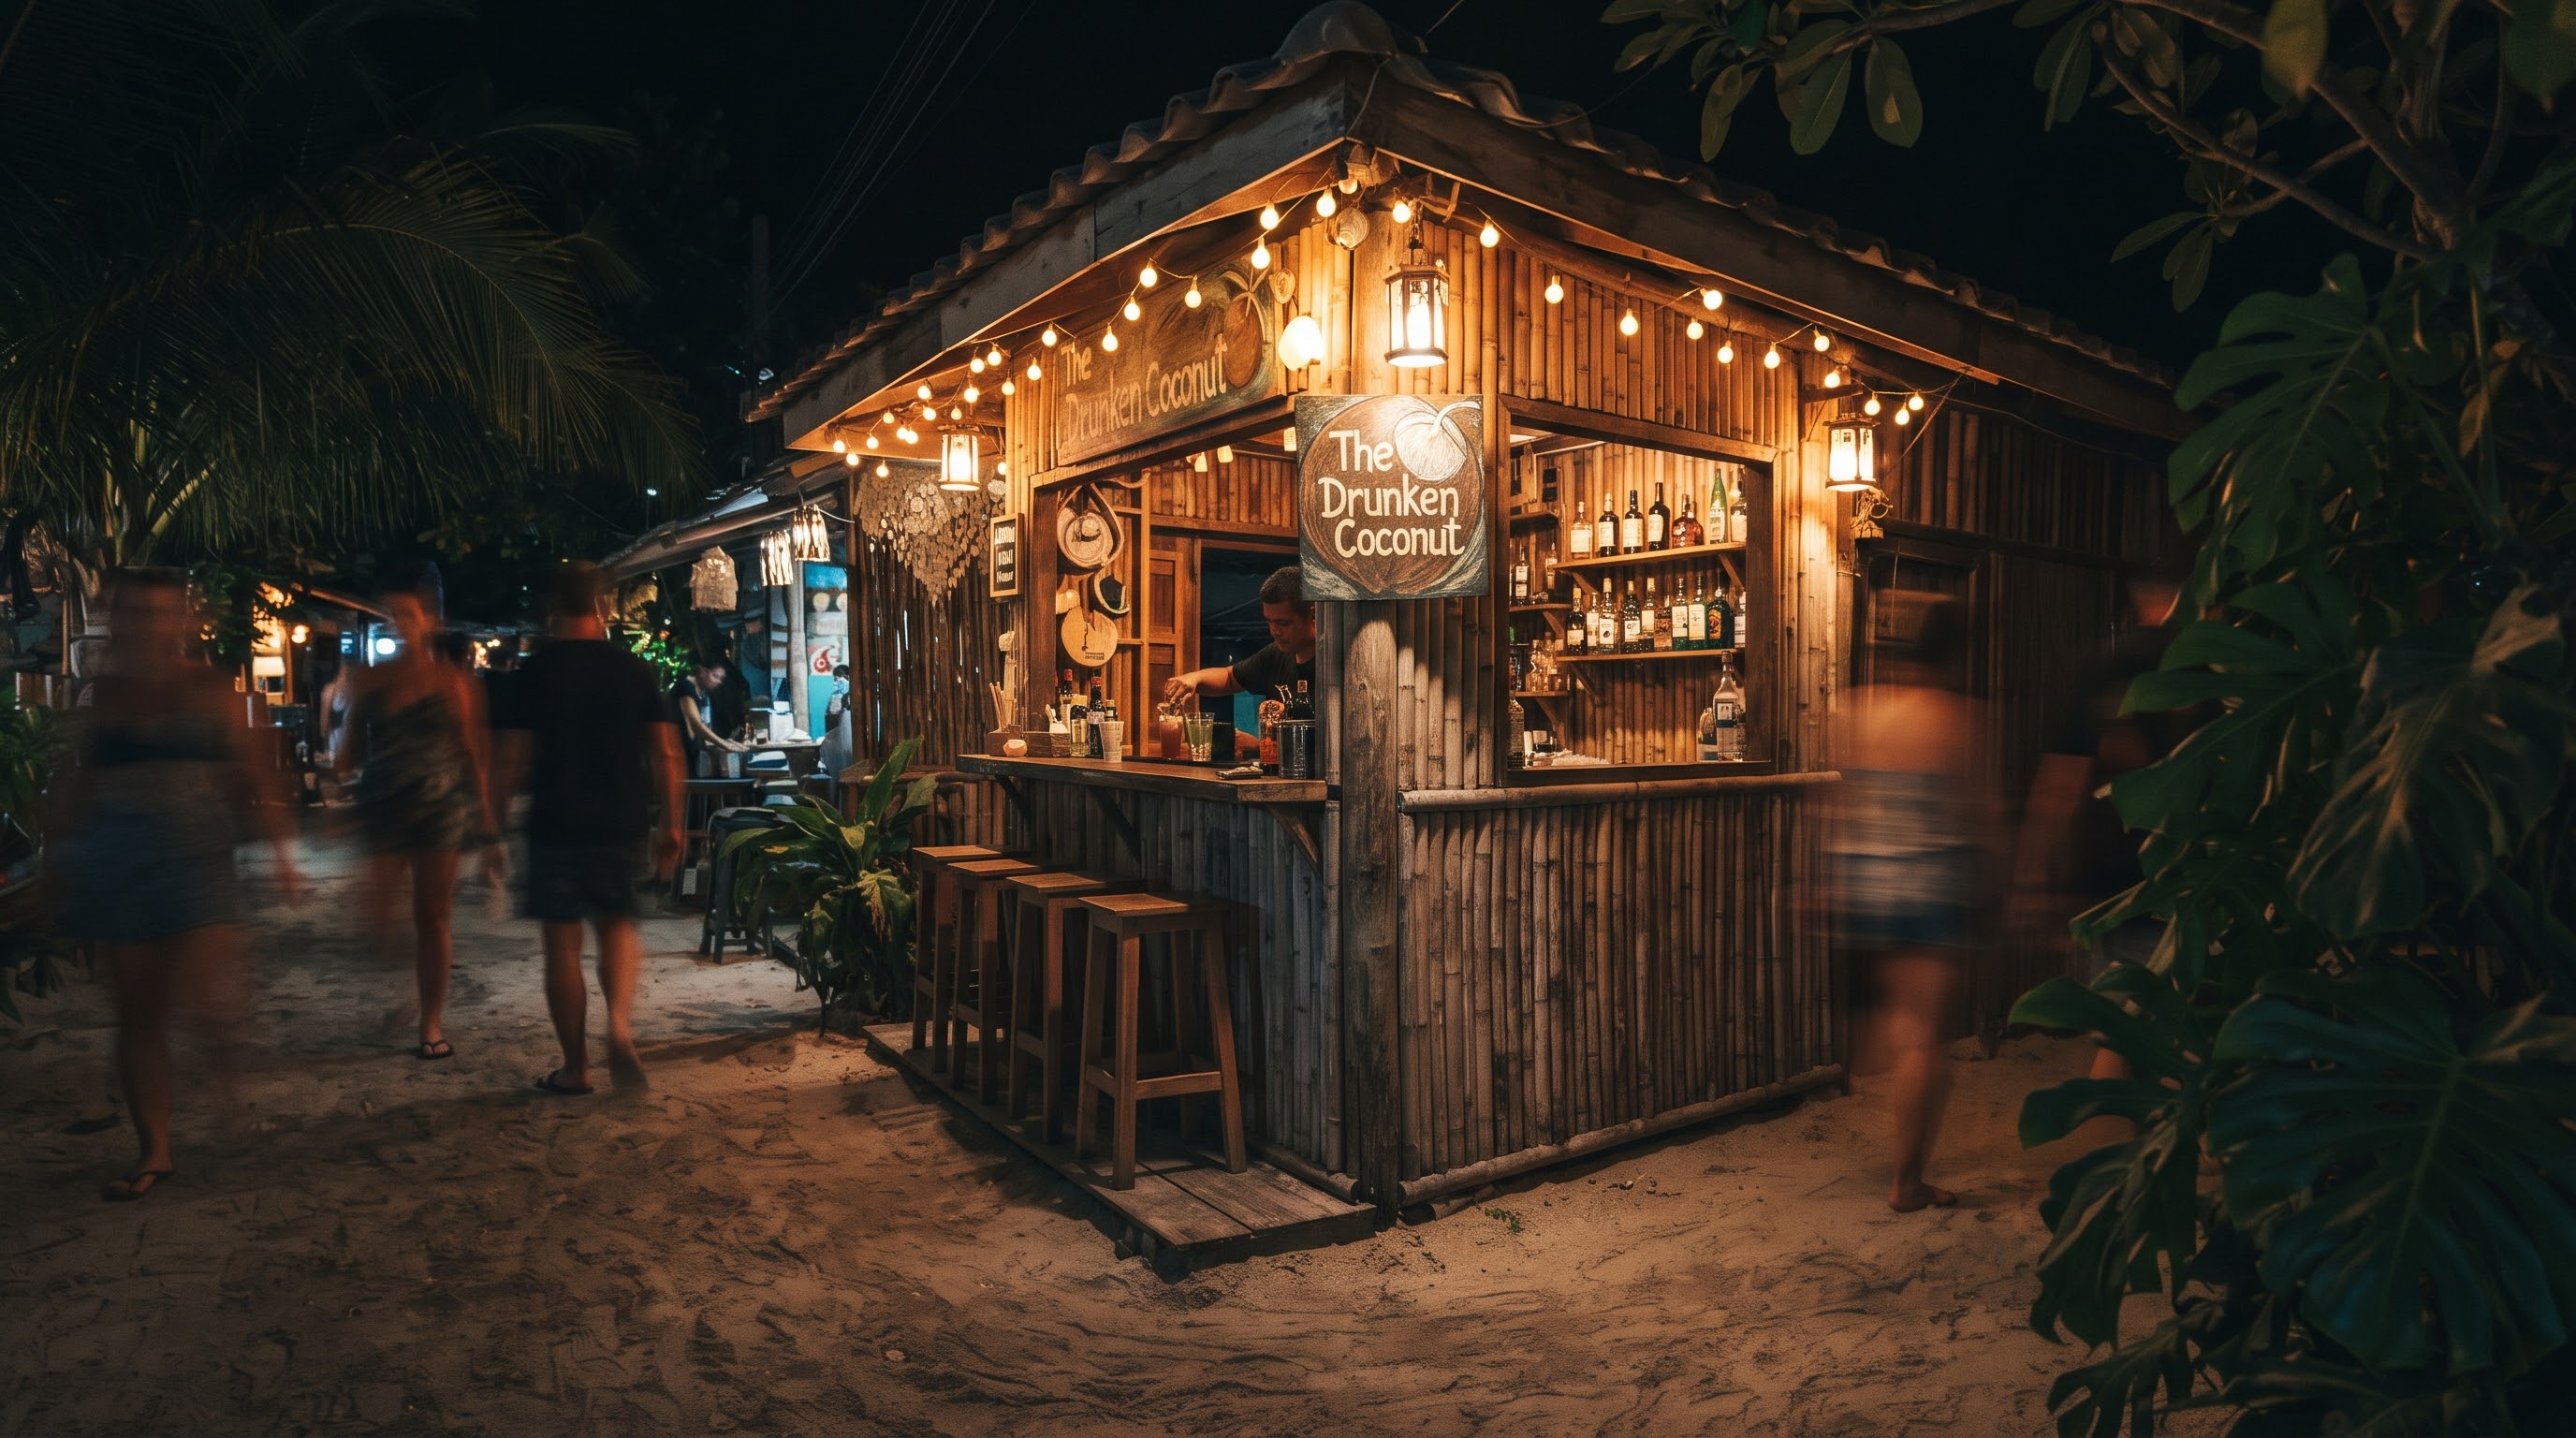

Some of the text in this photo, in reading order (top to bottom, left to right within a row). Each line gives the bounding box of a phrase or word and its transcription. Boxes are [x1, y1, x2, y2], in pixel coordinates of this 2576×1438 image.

[1061, 343, 1092, 387] The
[1064, 333, 1228, 446] Drunken Coconut
[1328, 429, 1393, 473] The
[1318, 473, 1459, 518] Drunken
[1334, 517, 1465, 558] Coconut
